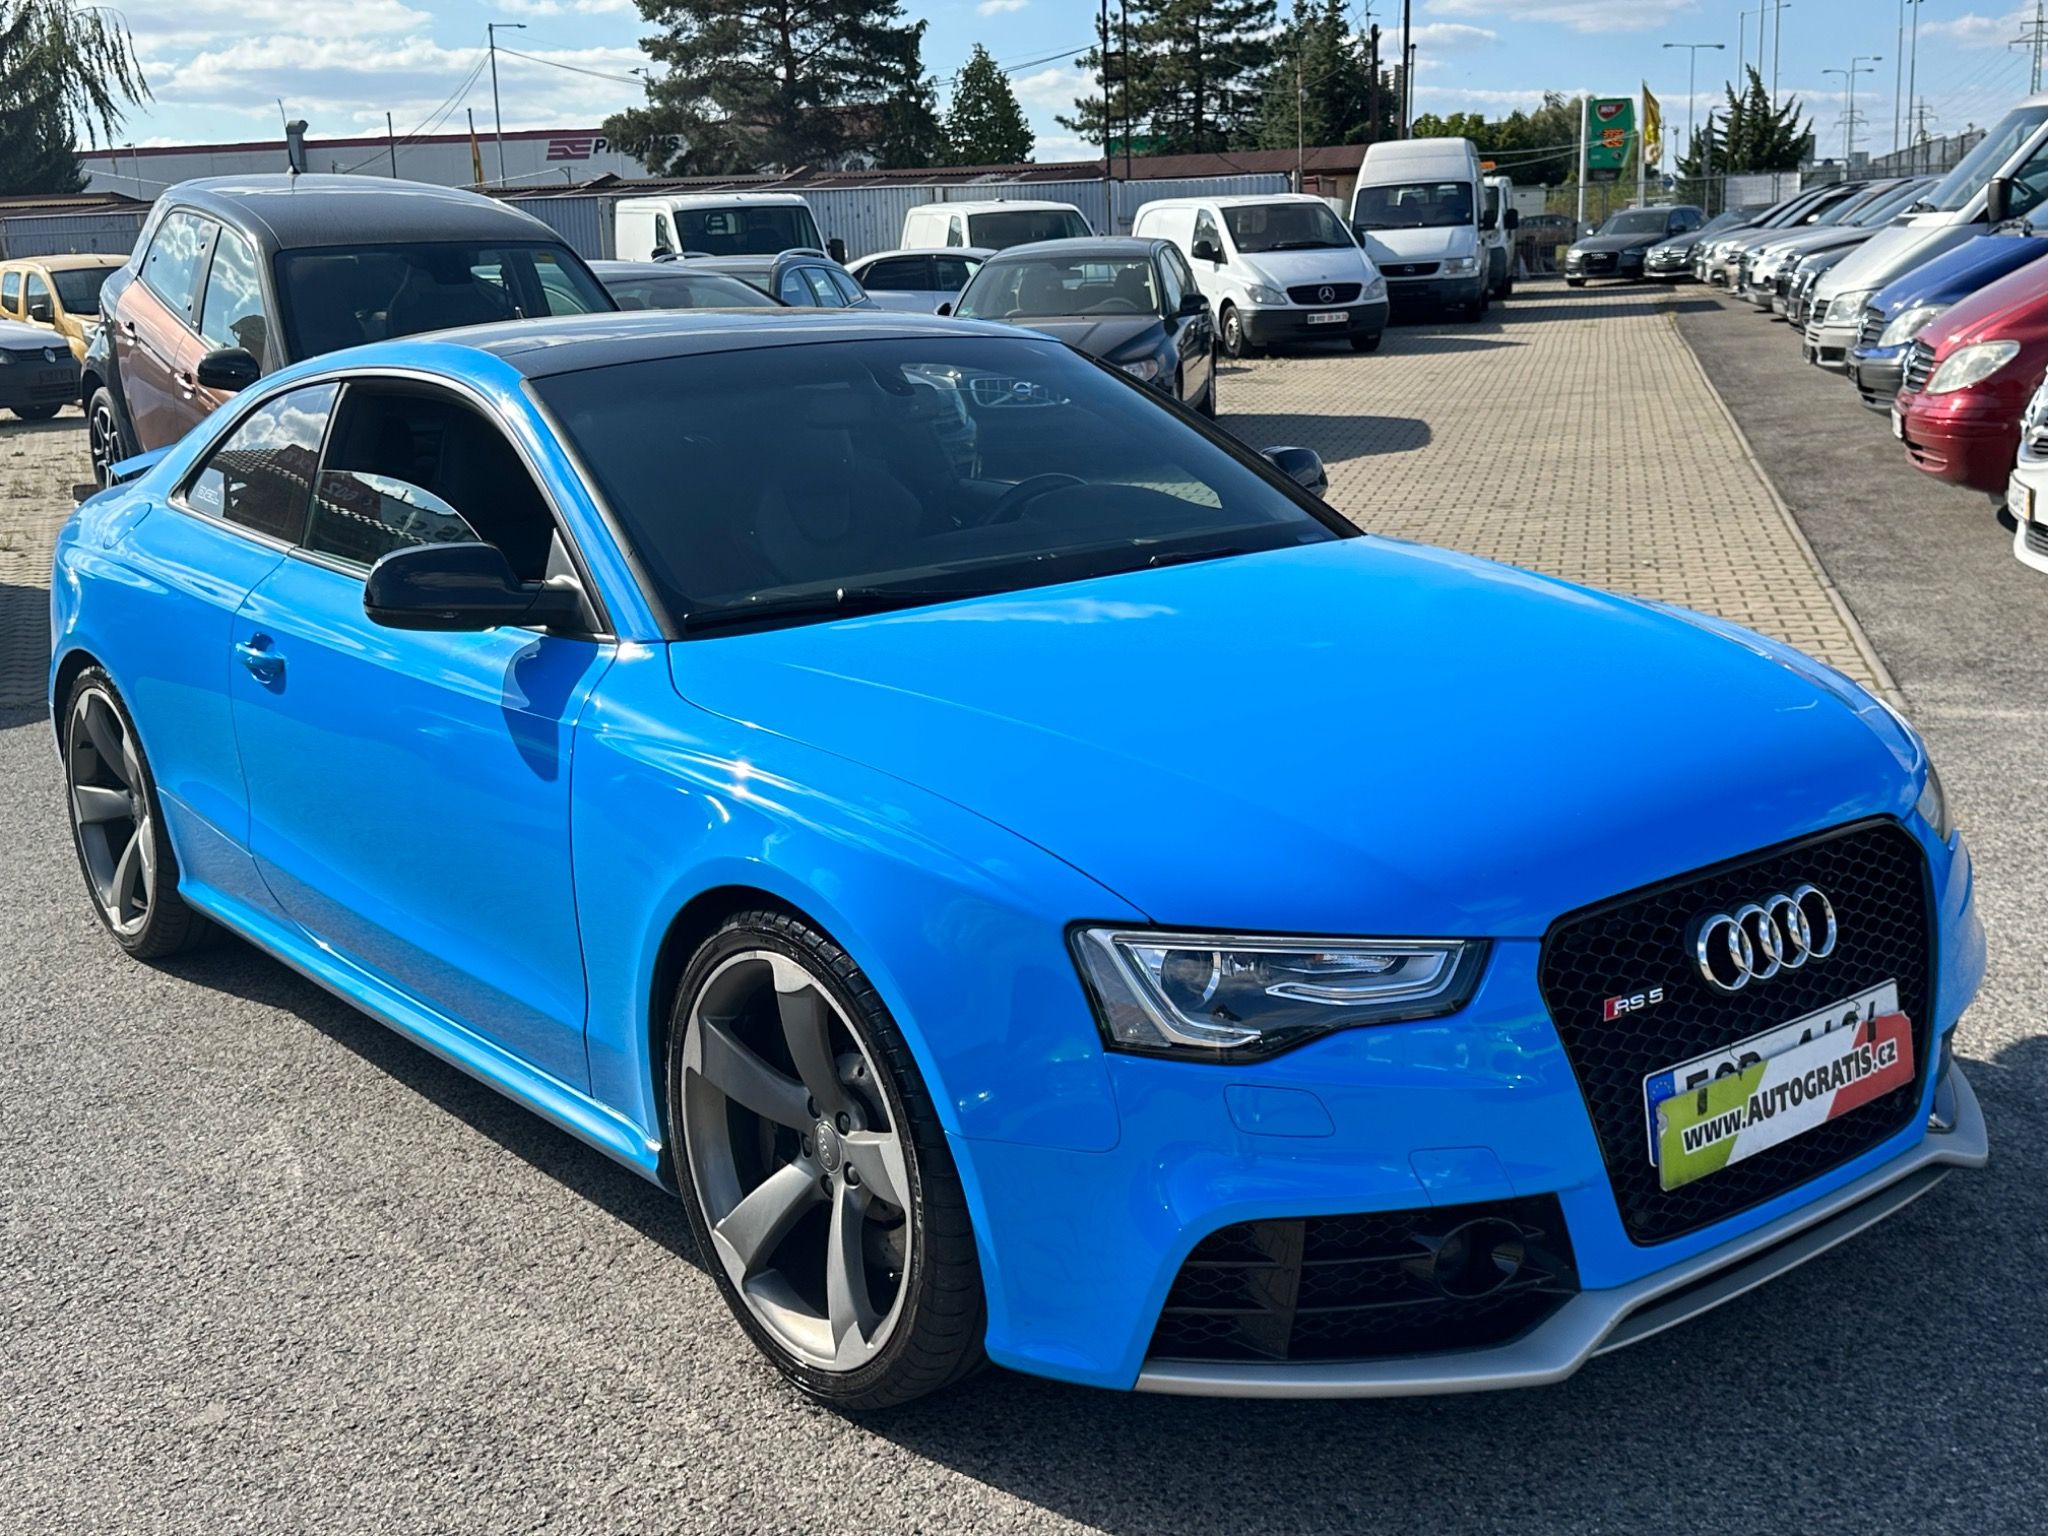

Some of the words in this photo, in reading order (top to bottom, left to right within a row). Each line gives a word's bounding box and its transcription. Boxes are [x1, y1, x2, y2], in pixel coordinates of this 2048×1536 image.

[1613, 993, 1646, 1016] RS
[1648, 987, 1664, 1004] 5
[1683, 1041, 1897, 1152] www.AUTOGRATIS.cz
